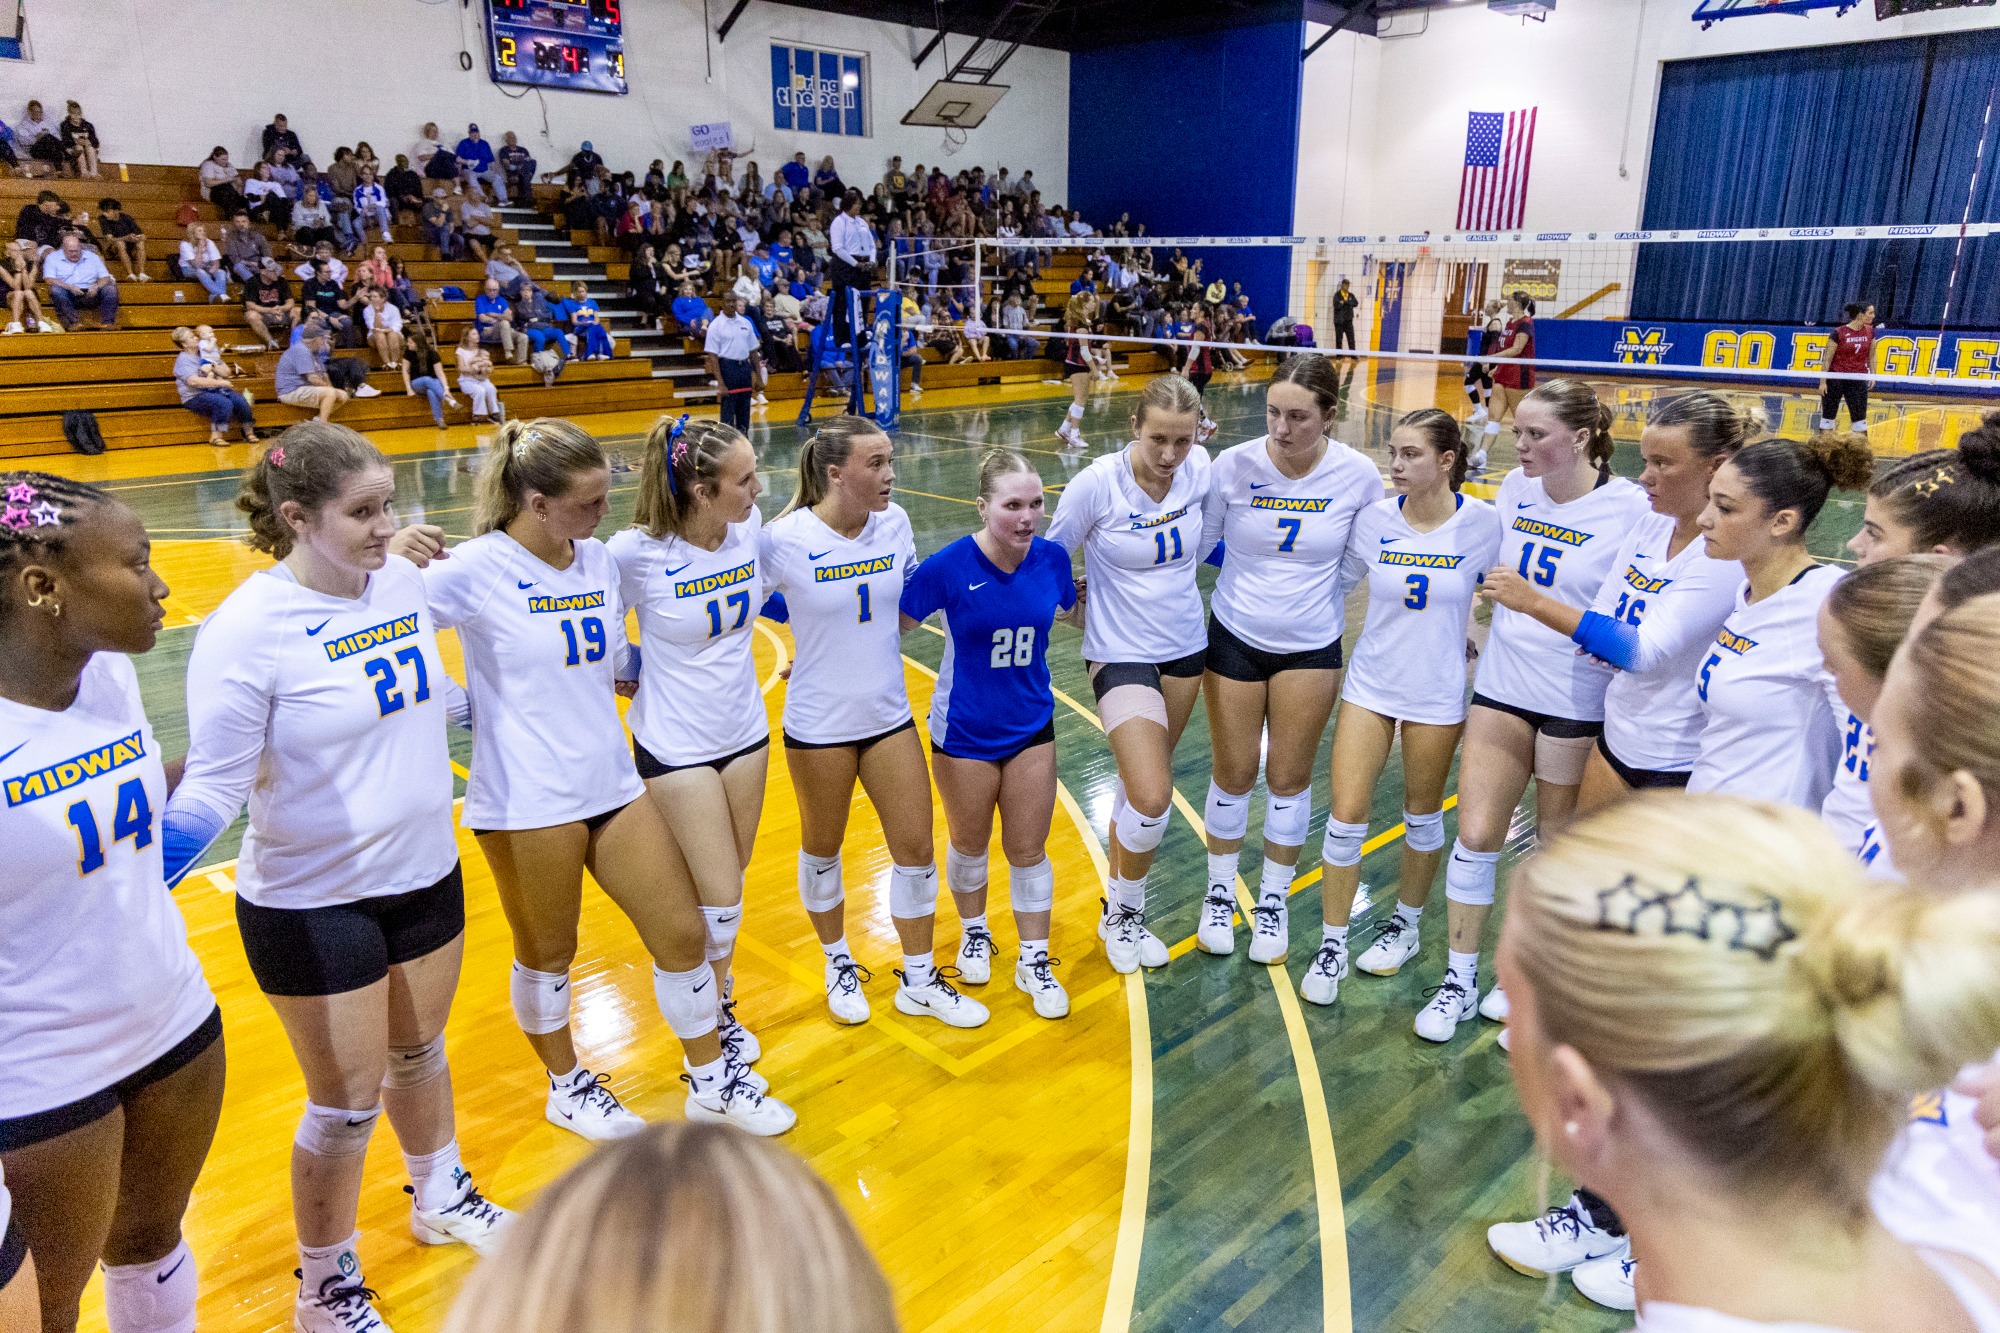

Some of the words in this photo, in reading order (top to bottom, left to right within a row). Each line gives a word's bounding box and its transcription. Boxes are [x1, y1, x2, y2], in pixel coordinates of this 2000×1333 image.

[501, 37, 517, 66] 2
[562, 46, 579, 73] 4
[692, 125, 709, 136] GO
[1537, 233, 1571, 241] MIDWAY
[1615, 232, 1652, 240] EAGLES
[1697, 230, 1739, 239] MIDWAY
[1790, 228, 1834, 236] EAGLES
[1888, 226, 1936, 235] MIDWAY
[1616, 344, 1669, 353] MIDWAY
[1701, 330, 1776, 370] GO
[1854, 343, 1861, 354] 7
[1251, 496, 1331, 512] MIDWAY
[1153, 525, 1184, 565] 11
[1276, 516, 1303, 553] 7
[1513, 517, 1591, 547] MIDWAY
[815, 554, 894, 582] MIDWAY
[1379, 551, 1464, 568] MIDWAY
[1518, 540, 1565, 589] 15
[676, 560, 754, 598] MIDWAY
[1403, 571, 1430, 612] 3
[529, 591, 604, 612] MIDWAY
[704, 588, 751, 640] 17
[856, 582, 873, 625] 1
[325, 613, 418, 661] MIDWAY
[559, 616, 606, 668] 19
[991, 626, 1036, 669] 28
[362, 643, 431, 719] 27
[4, 731, 146, 806] MIDWAY
[64, 774, 155, 878] 14
